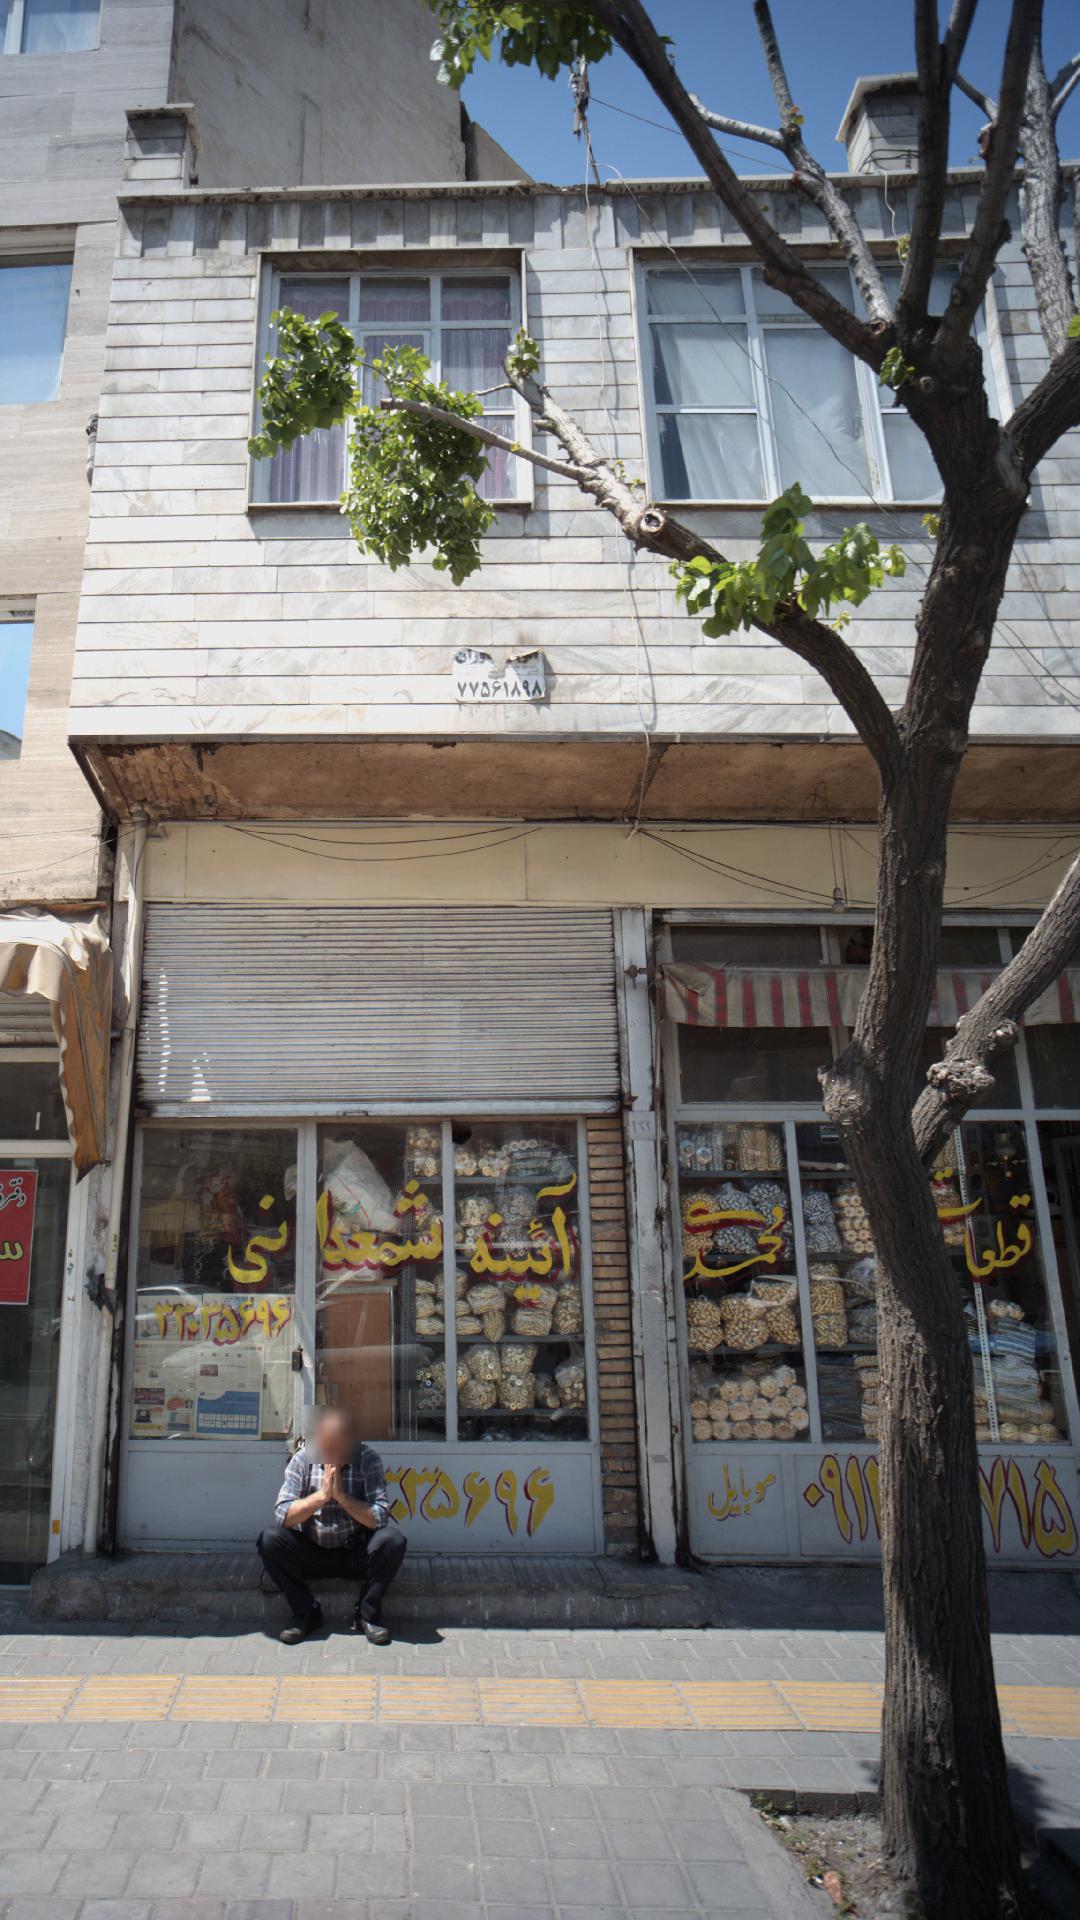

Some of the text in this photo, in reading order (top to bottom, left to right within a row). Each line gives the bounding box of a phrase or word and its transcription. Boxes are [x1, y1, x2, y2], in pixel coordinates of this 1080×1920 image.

[457, 680, 542, 698] ۷۷۵۶۱۸۹۸
[683, 1200, 785, 1284] محمدی
[155, 1298, 294, 1347] ۳۳۰۳۵۶۹۶
[707, 1464, 776, 1521] موبایل
